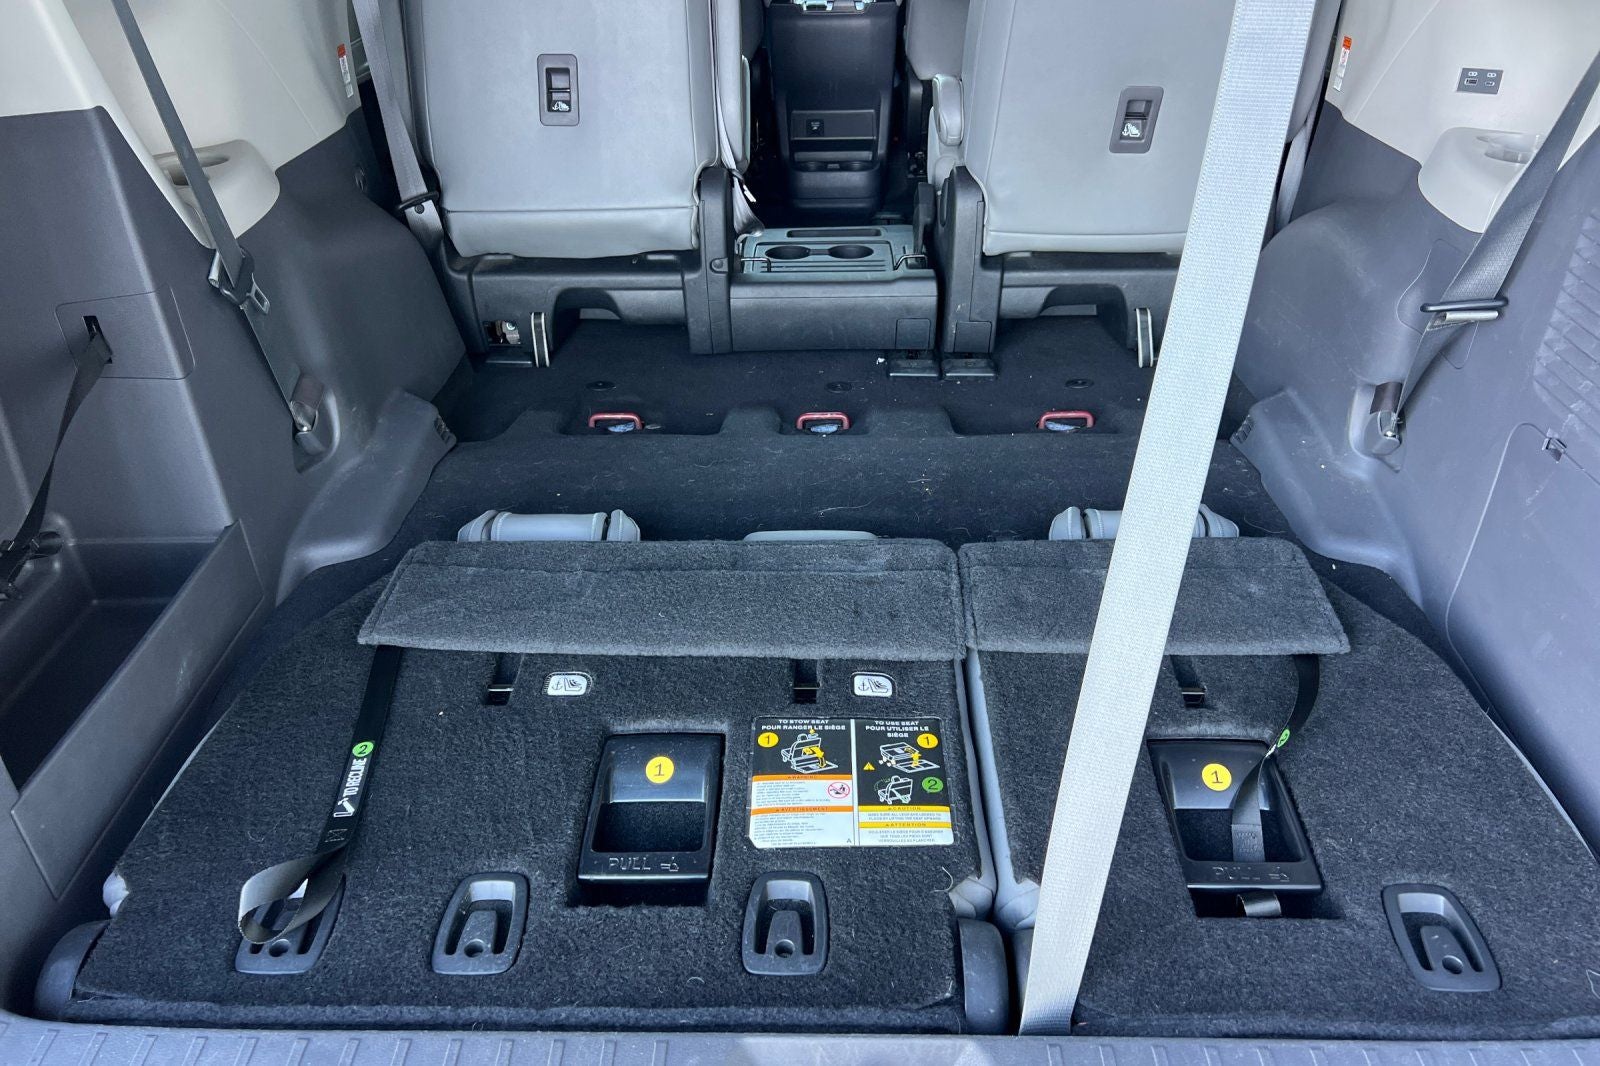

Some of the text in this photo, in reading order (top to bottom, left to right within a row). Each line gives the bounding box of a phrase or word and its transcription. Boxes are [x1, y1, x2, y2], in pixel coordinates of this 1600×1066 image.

[653, 763, 665, 777] 1
[1211, 770, 1223, 784] 1
[343, 757, 368, 798] TO RECLINE
[608, 857, 651, 870] PULL
